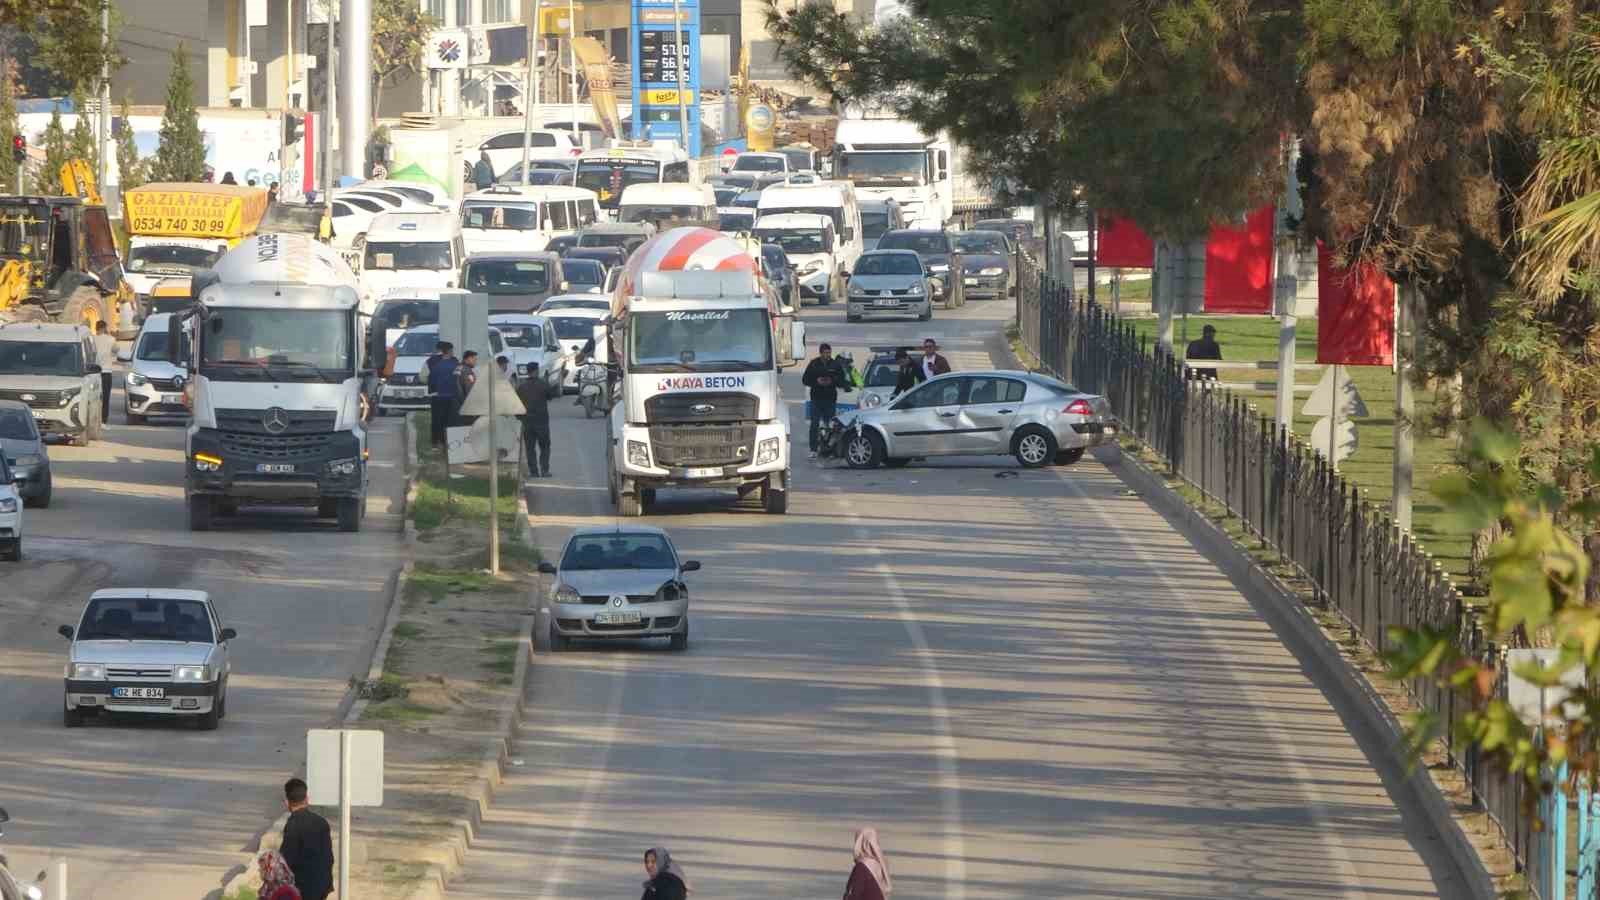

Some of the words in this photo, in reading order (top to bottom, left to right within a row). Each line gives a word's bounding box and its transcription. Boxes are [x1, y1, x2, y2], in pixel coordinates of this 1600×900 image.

[134, 218, 162, 231] 0534
[166, 218, 188, 231] 740
[191, 219, 207, 232] 30
[209, 220, 224, 232] 99
[672, 377, 704, 389] KAYA
[705, 376, 745, 388] BETON
[118, 688, 129, 697] 02
